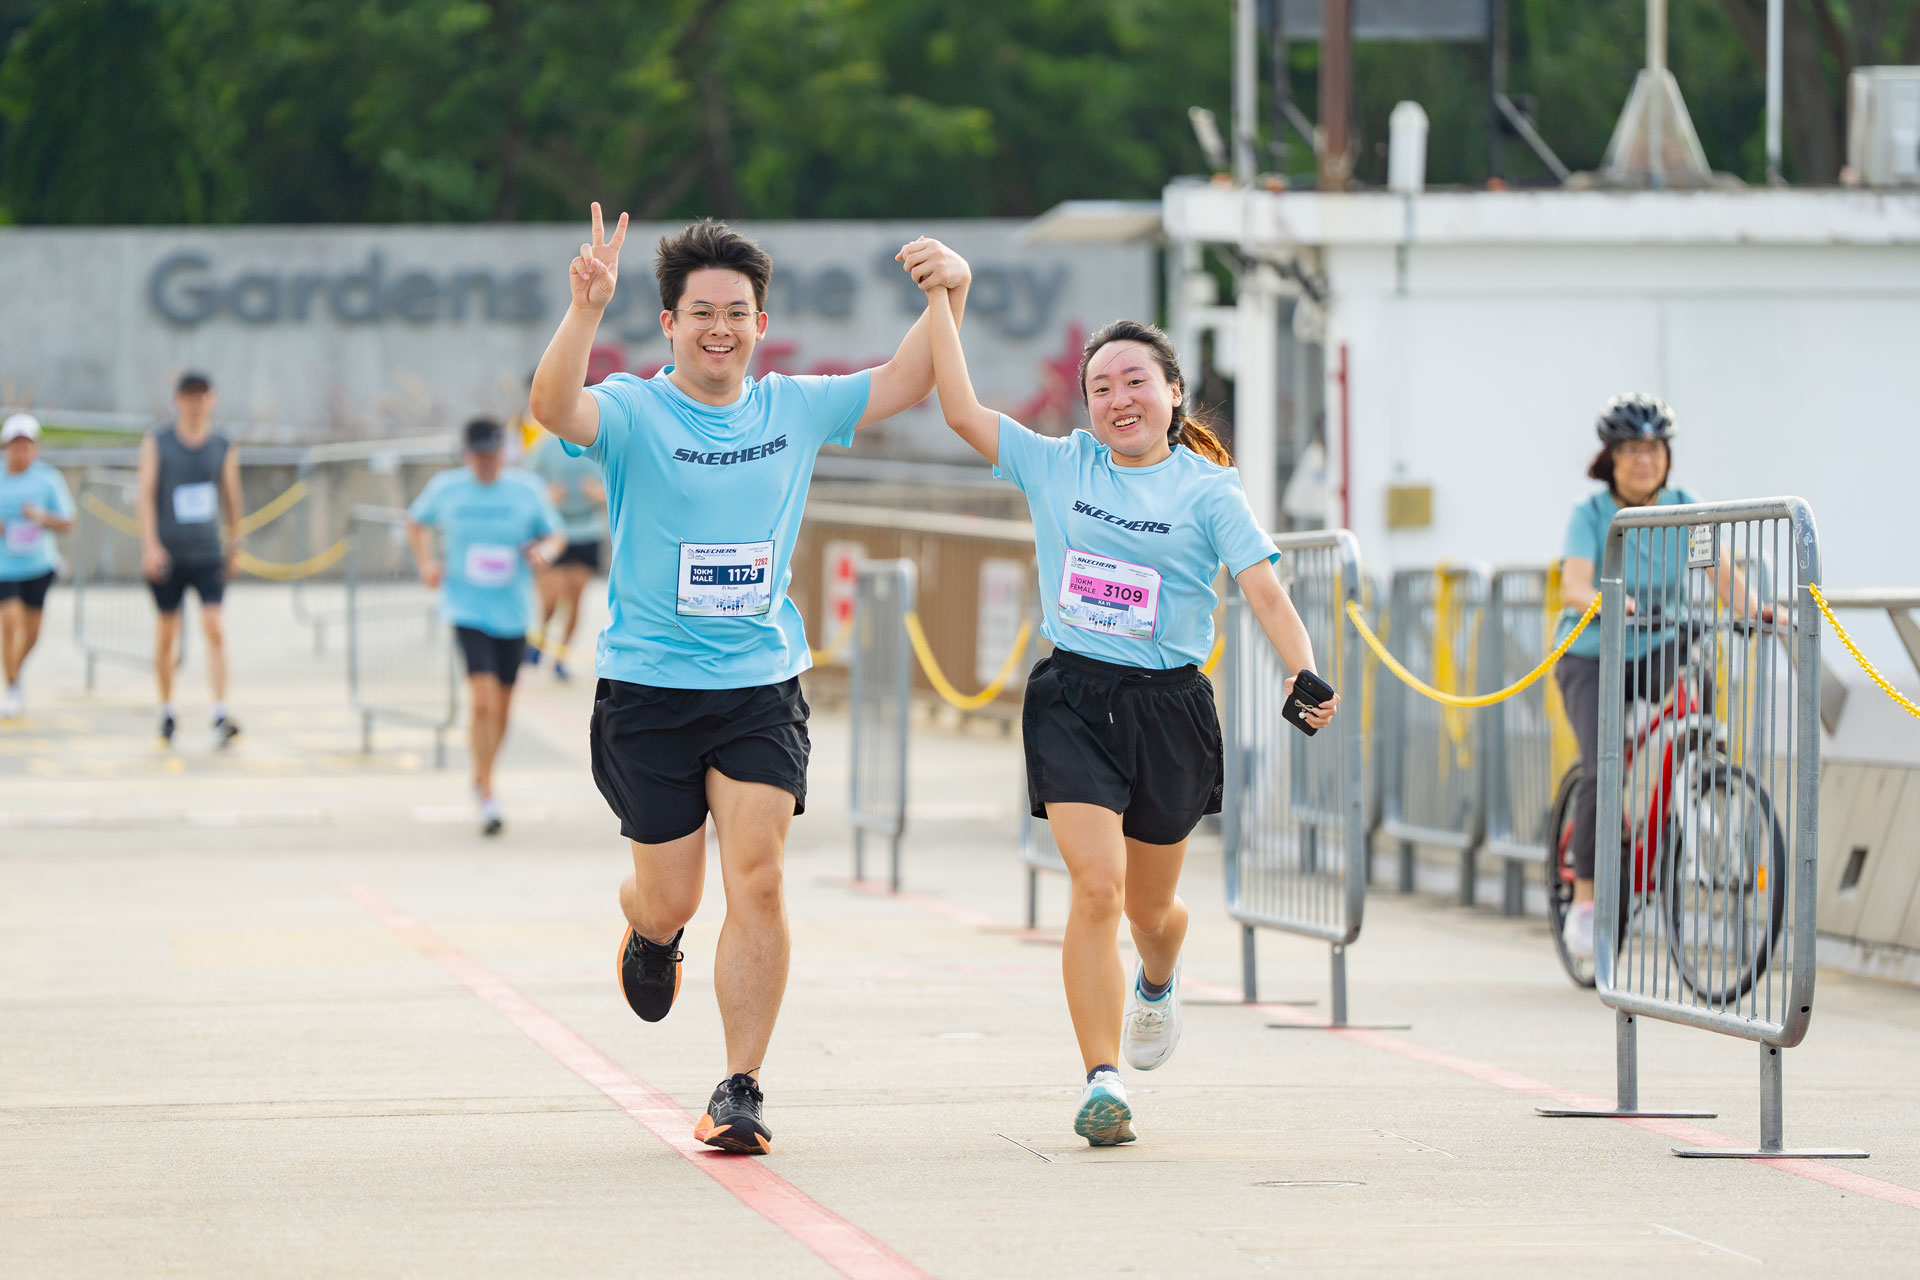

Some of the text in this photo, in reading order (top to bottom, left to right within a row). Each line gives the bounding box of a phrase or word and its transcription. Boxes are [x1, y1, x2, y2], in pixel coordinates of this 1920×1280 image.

[147, 248, 548, 328] Gardens
[672, 434, 788, 465] SKECHERS
[1072, 500, 1172, 534] SKECHERS
[1077, 557, 1118, 570] SKECHERS
[728, 568, 758, 582] 1179
[1075, 577, 1093, 586] 10KM
[1070, 583, 1097, 595] FEMALE
[1103, 584, 1143, 603] 3109
